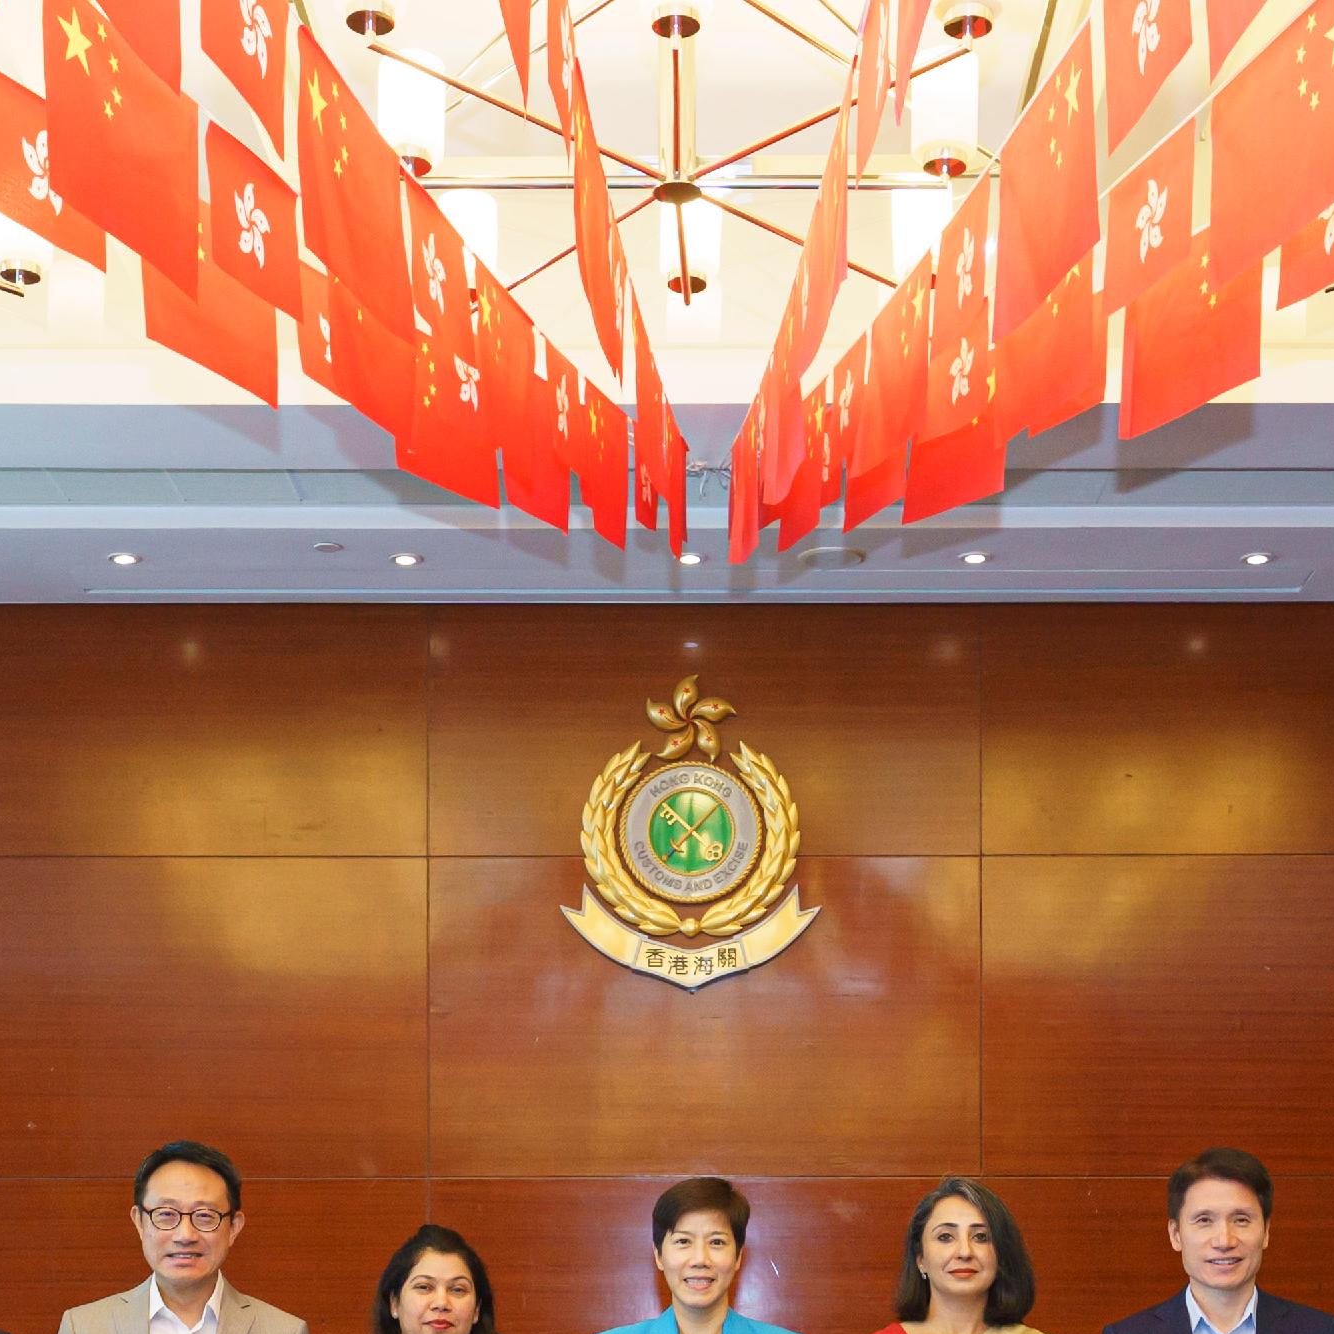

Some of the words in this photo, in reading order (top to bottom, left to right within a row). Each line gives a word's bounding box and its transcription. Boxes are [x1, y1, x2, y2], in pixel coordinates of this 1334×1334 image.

[650, 772, 691, 797] HONG
[693, 772, 733, 798] KONG
[634, 841, 682, 889] CUSTOMS
[683, 878, 713, 893] AND
[714, 841, 748, 883] EXCISE
[645, 948, 737, 975] 香港海關
